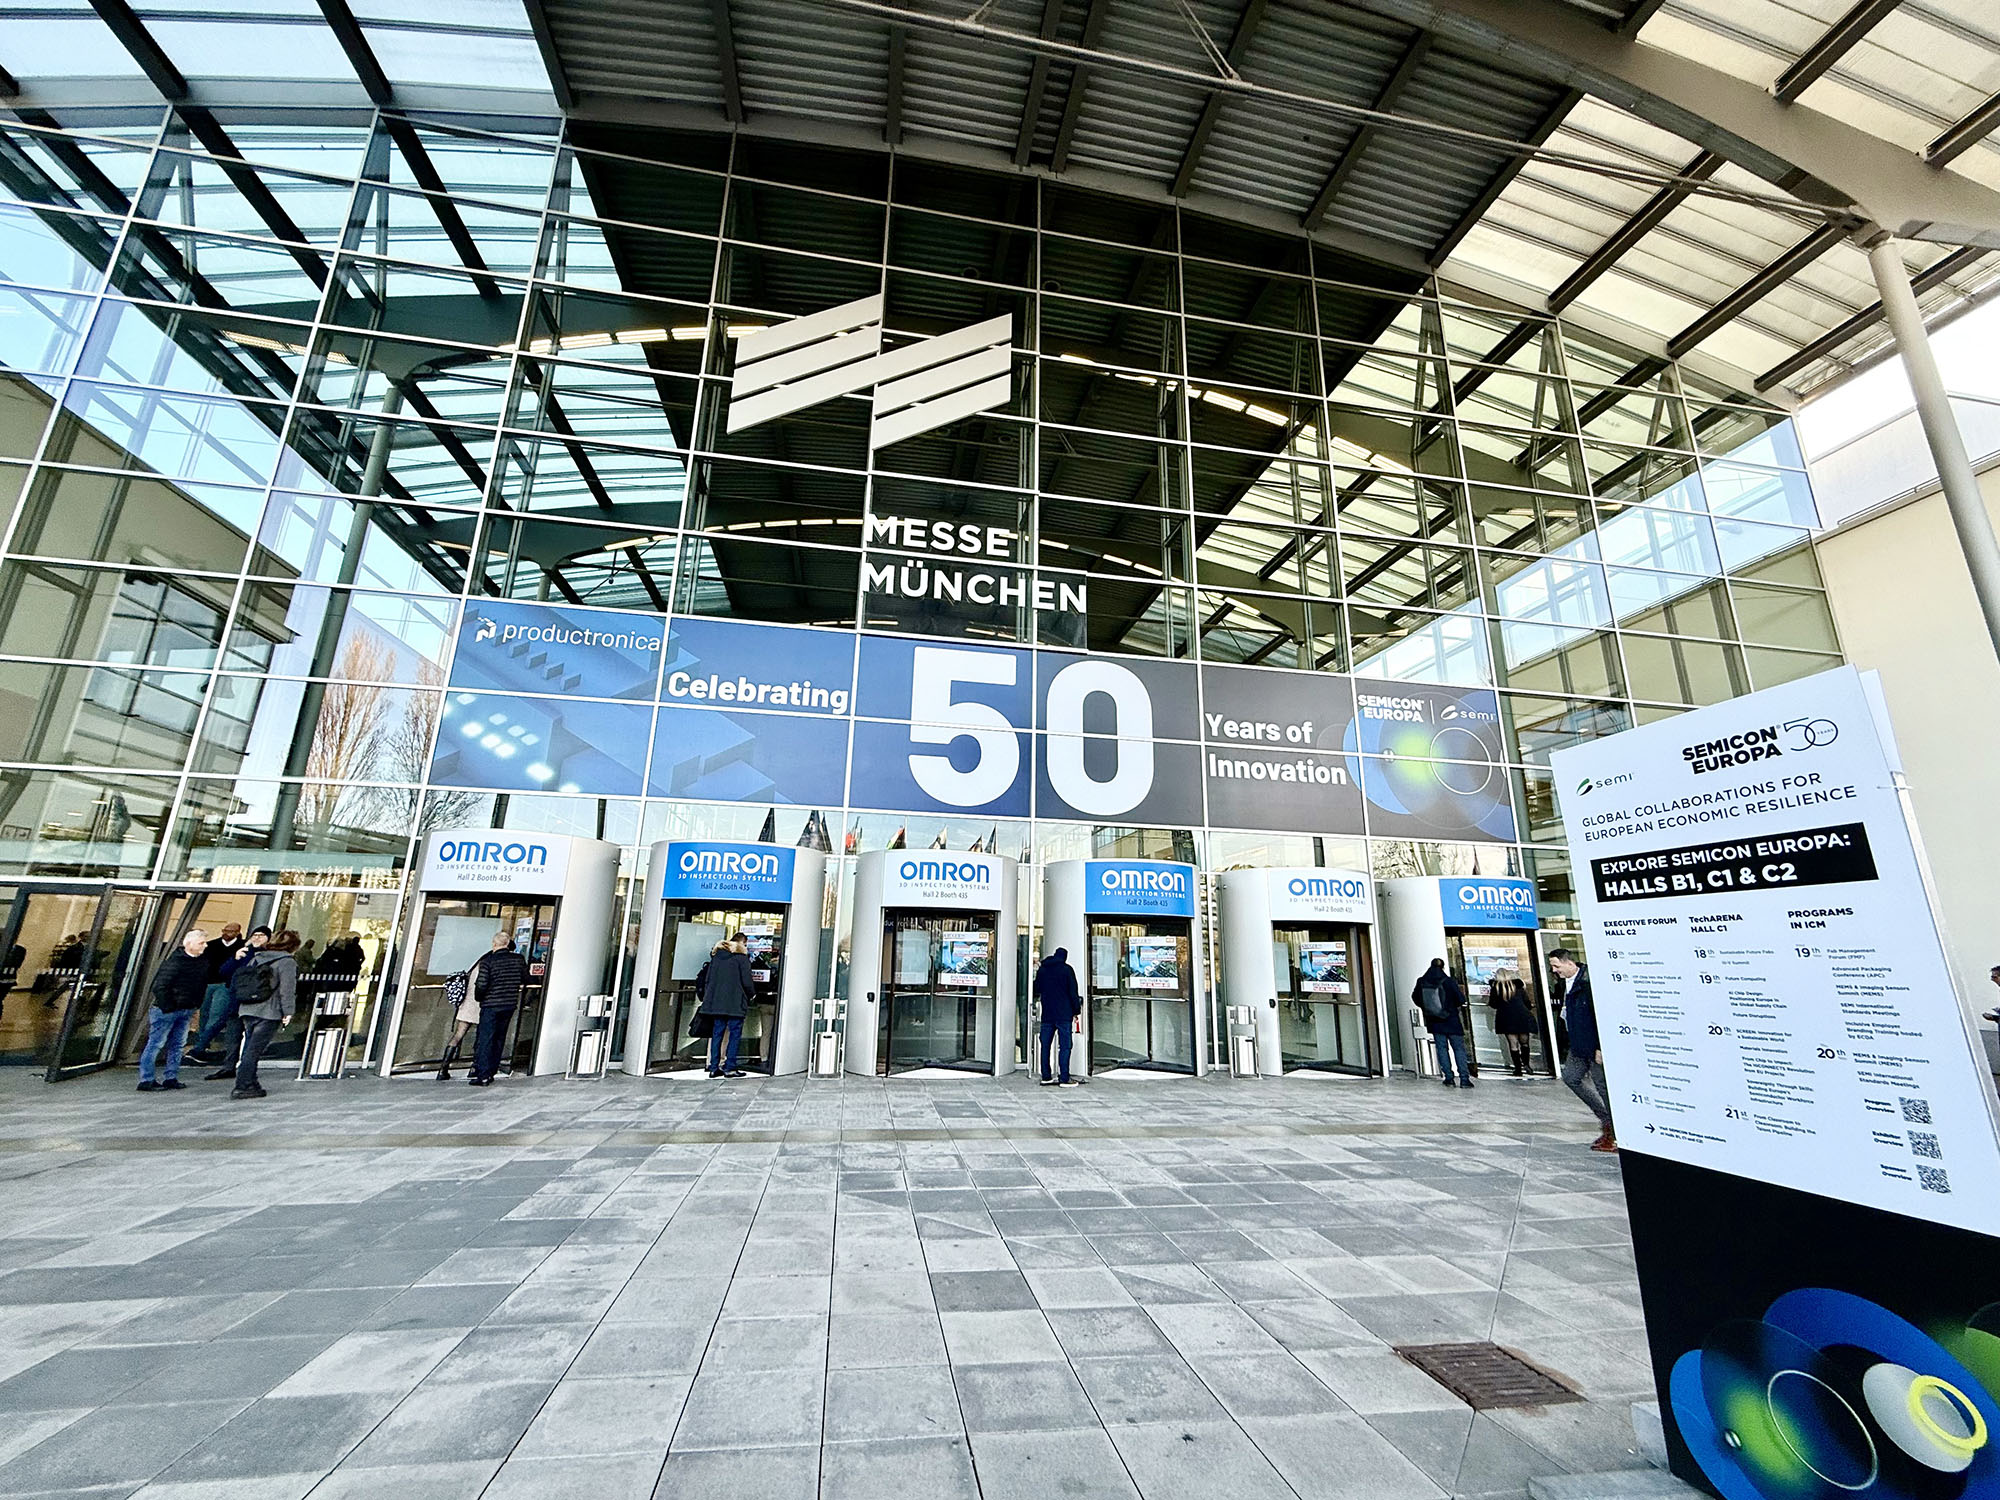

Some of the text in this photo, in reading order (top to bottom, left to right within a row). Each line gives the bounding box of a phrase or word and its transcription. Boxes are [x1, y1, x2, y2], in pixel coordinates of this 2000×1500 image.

[865, 514, 1010, 557] MESSE
[863, 560, 1086, 614] MÜNCHEN
[502, 624, 660, 651] productronica
[668, 670, 848, 715] Celebrating
[1358, 695, 1422, 710] SEMICON
[1364, 707, 1423, 722] EUROPA
[1460, 710, 1494, 721] semi
[909, 646, 1154, 816] 50
[1205, 713, 1312, 744] Years of
[1783, 717, 1838, 751] 50
[1683, 726, 1778, 761] SEMICON
[1209, 753, 1347, 785] Innovation
[1692, 743, 1782, 774] EUROPA
[1596, 772, 1633, 789] semi
[1582, 773, 1822, 827] GLOBAL COLLABORATIONS FOR
[1585, 786, 1857, 842] EUROPEAN ECONOMIC RESILIENCE
[440, 841, 547, 865] OMRON
[680, 851, 778, 875] OMRON
[1601, 833, 1851, 874] EXPLORE SEMICON EUROPA:
[900, 861, 989, 883] OMRON
[1102, 870, 1184, 892] OMRON
[1605, 863, 1797, 896] HALLS B1, C1 & C2
[1288, 878, 1365, 898] OMRON
[1459, 886, 1532, 906] OMRON
[1604, 919, 1646, 927] EXECUTIVE
[1689, 914, 1743, 923] TechARENA
[1788, 908, 1854, 918] PROGRAMS
